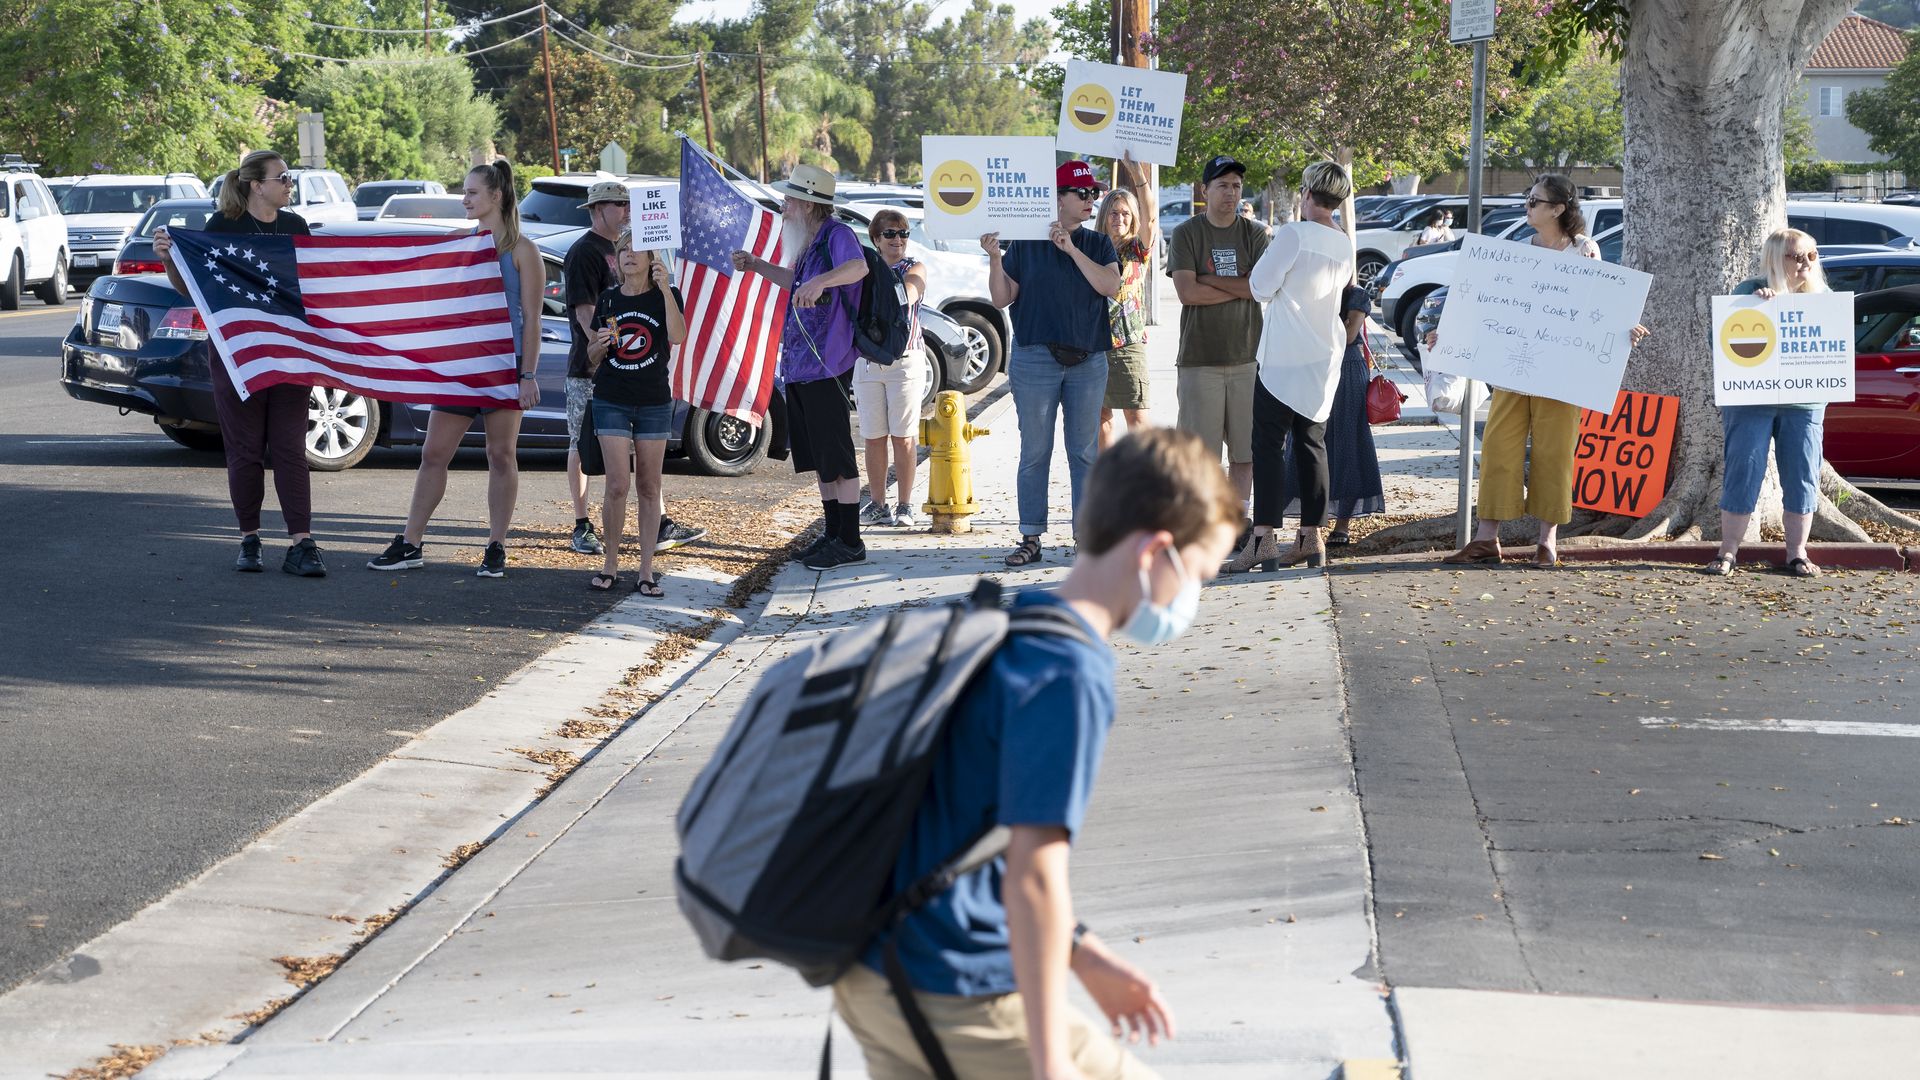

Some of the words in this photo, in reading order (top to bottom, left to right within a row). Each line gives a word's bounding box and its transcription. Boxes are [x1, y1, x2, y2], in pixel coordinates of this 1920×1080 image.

[1121, 86, 1143, 98] LET
[1120, 99, 1155, 113] THEM
[1118, 111, 1175, 129] BREATHE
[1116, 129, 1138, 137] STUDENT
[987, 157, 1010, 169] LET
[986, 172, 1027, 184] THEM
[646, 190, 661, 199] BE
[988, 186, 1050, 198] BREATHE
[642, 201, 667, 211] LIKE
[641, 212, 669, 221] EZRA!
[642, 234, 672, 243] RIGHTS!
[1494, 273, 1513, 284] are
[1780, 311, 1804, 323] LET
[1780, 326, 1822, 338] THEM
[1781, 340, 1846, 353] BREATHE
[1722, 379, 1781, 391] UNMASK
[1784, 378, 1813, 389] OUR
[1816, 377, 1847, 388] KIDS
[1615, 440, 1655, 469] GO
